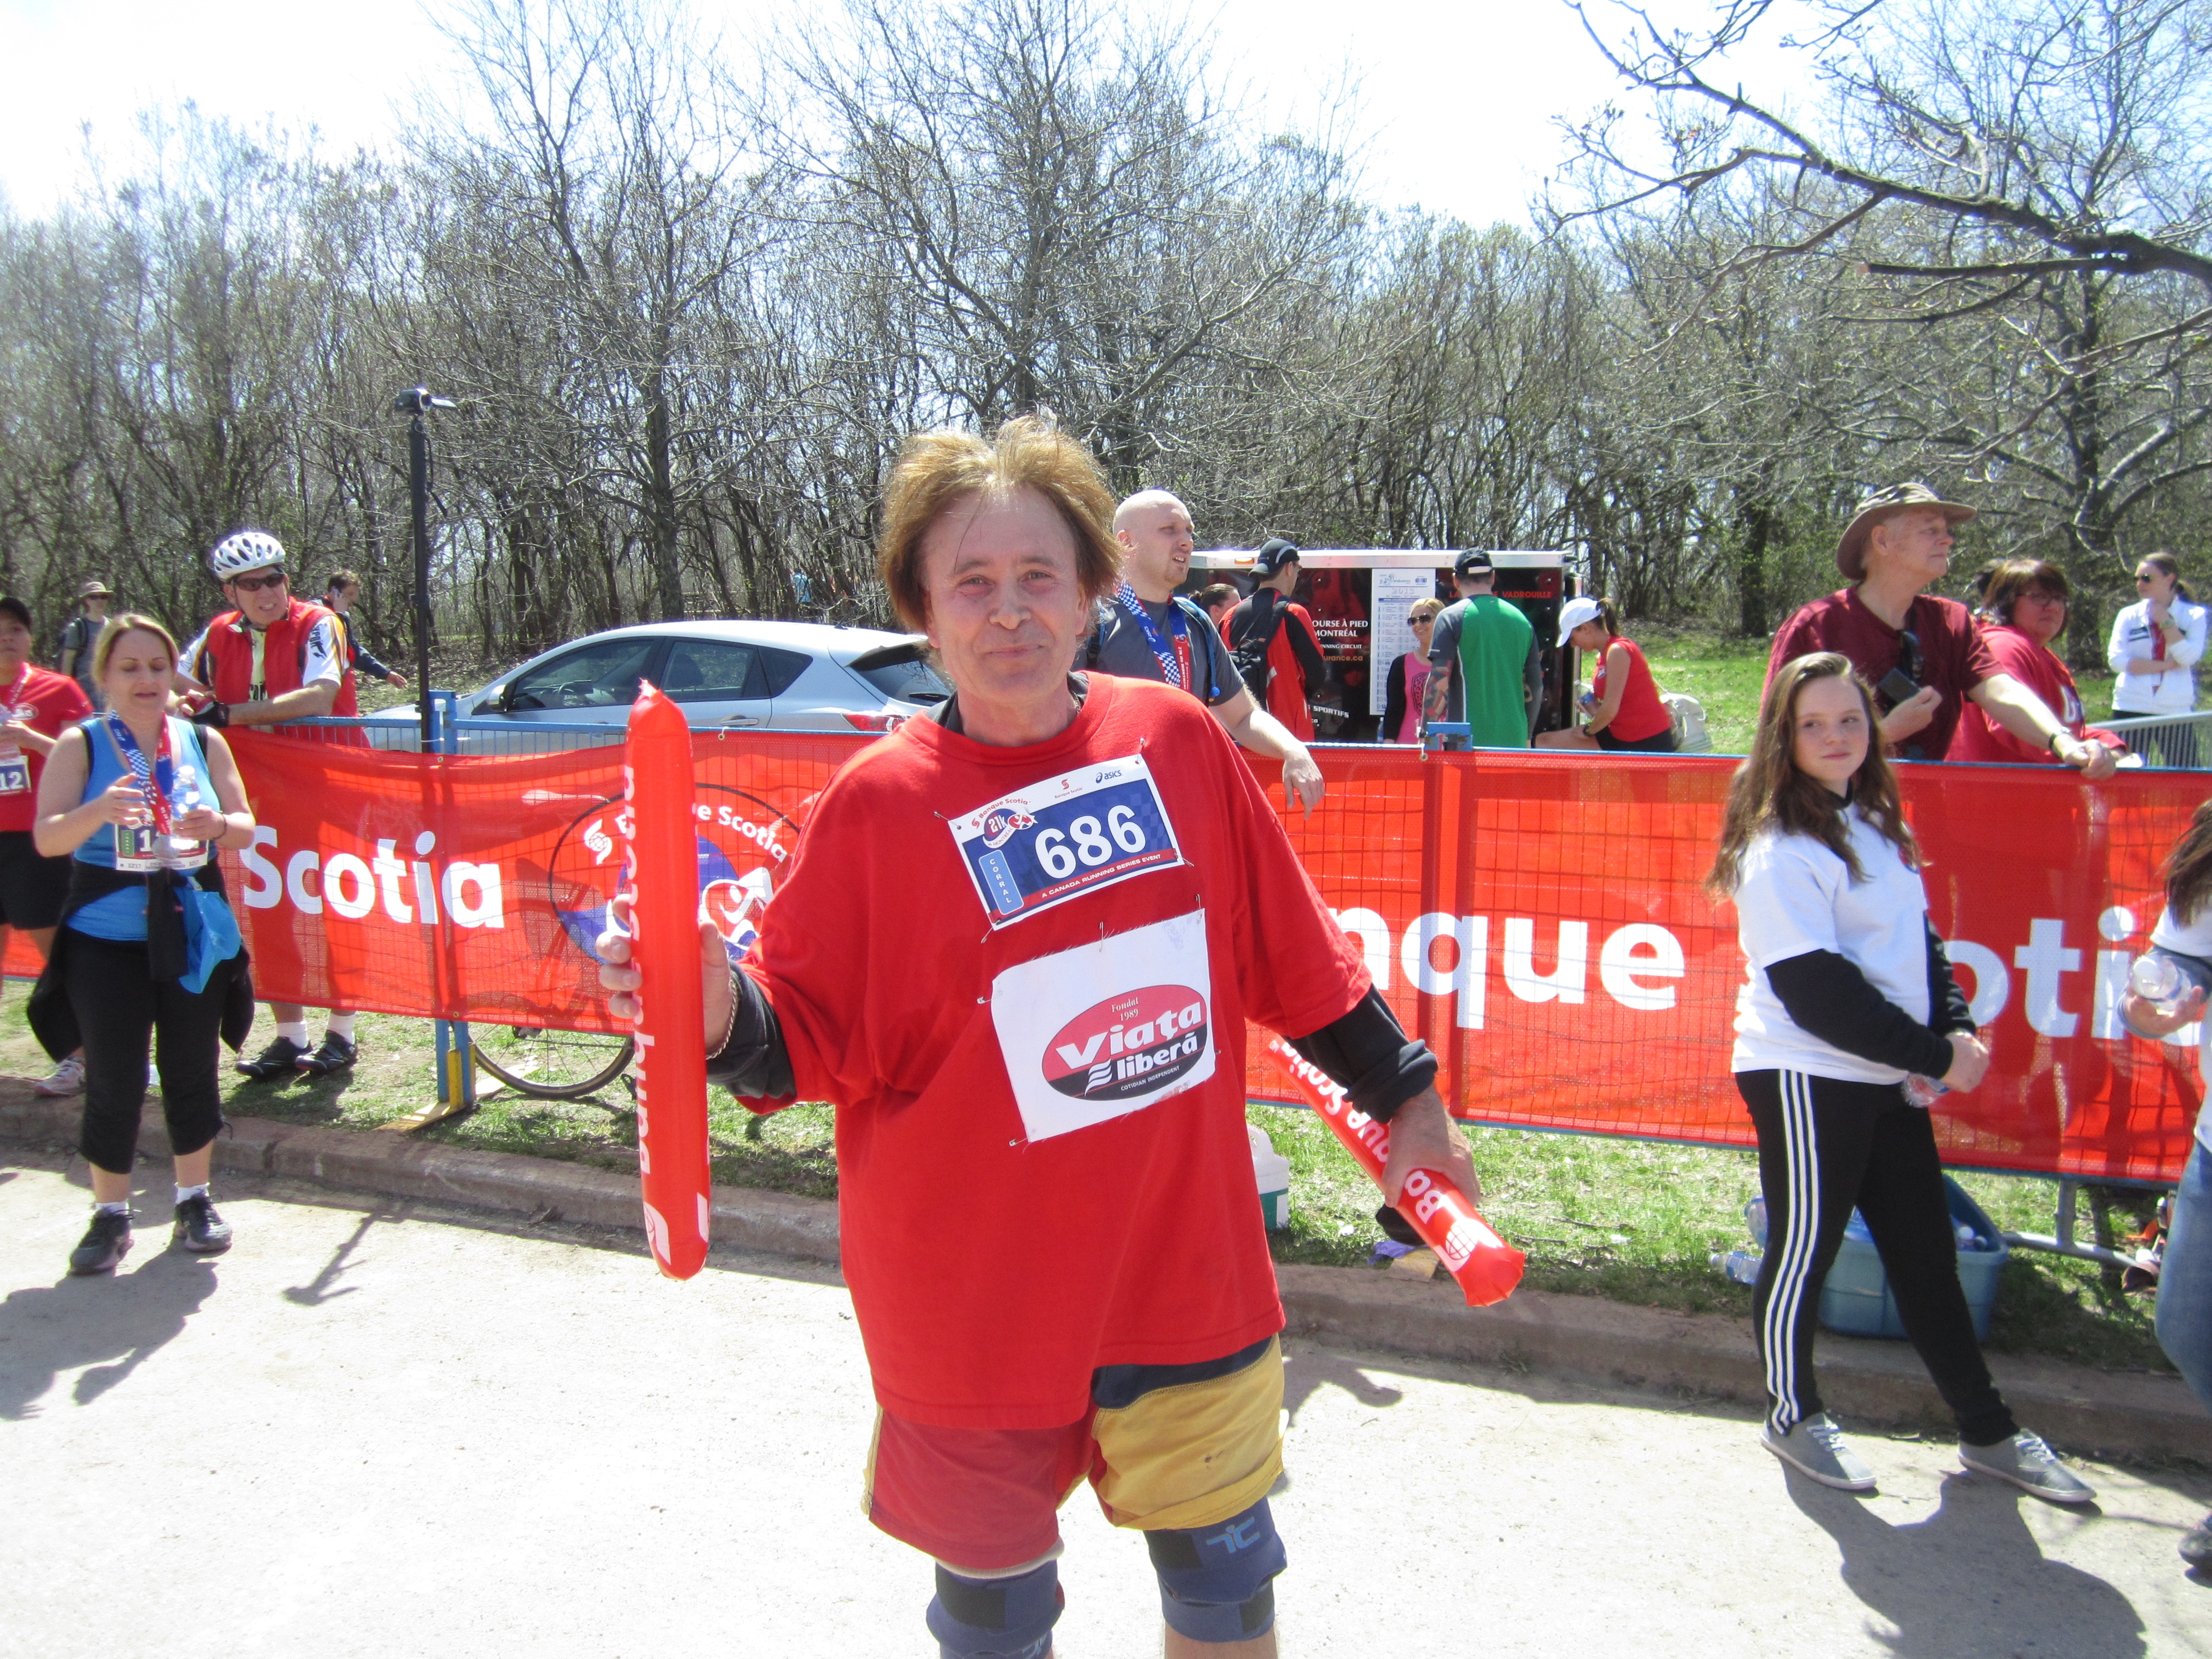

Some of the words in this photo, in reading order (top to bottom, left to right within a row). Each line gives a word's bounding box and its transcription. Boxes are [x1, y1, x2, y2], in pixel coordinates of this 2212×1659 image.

[1342, 618, 1348, 627] À
[1313, 705, 1349, 718] SPORTIFS
[1104, 770, 1122, 780] asics
[1054, 791, 1070, 799] Banque
[979, 801, 1004, 819] Banque
[718, 805, 788, 862] Scotia
[988, 815, 1008, 833] 21k
[993, 827, 1013, 846] MONTRÉAL
[1035, 804, 1146, 879] 686
[239, 825, 504, 928] Scotia
[989, 859, 1012, 903] CORRAL
[1049, 880, 1081, 895] CANADA
[1081, 867, 1115, 883] RUNNING
[1116, 858, 1141, 871] SERIES
[1141, 854, 1161, 863] EVENT
[1328, 907, 1686, 1030] nque
[1944, 906, 2201, 1046] oti
[1112, 997, 1138, 1013] Fondat
[1120, 1008, 1138, 1022] 1989
[1120, 1079, 1146, 1091] COTIDIAN
[1147, 1065, 1180, 1082] INDEPENDENT
[1347, 1112, 1442, 1225] Baque
